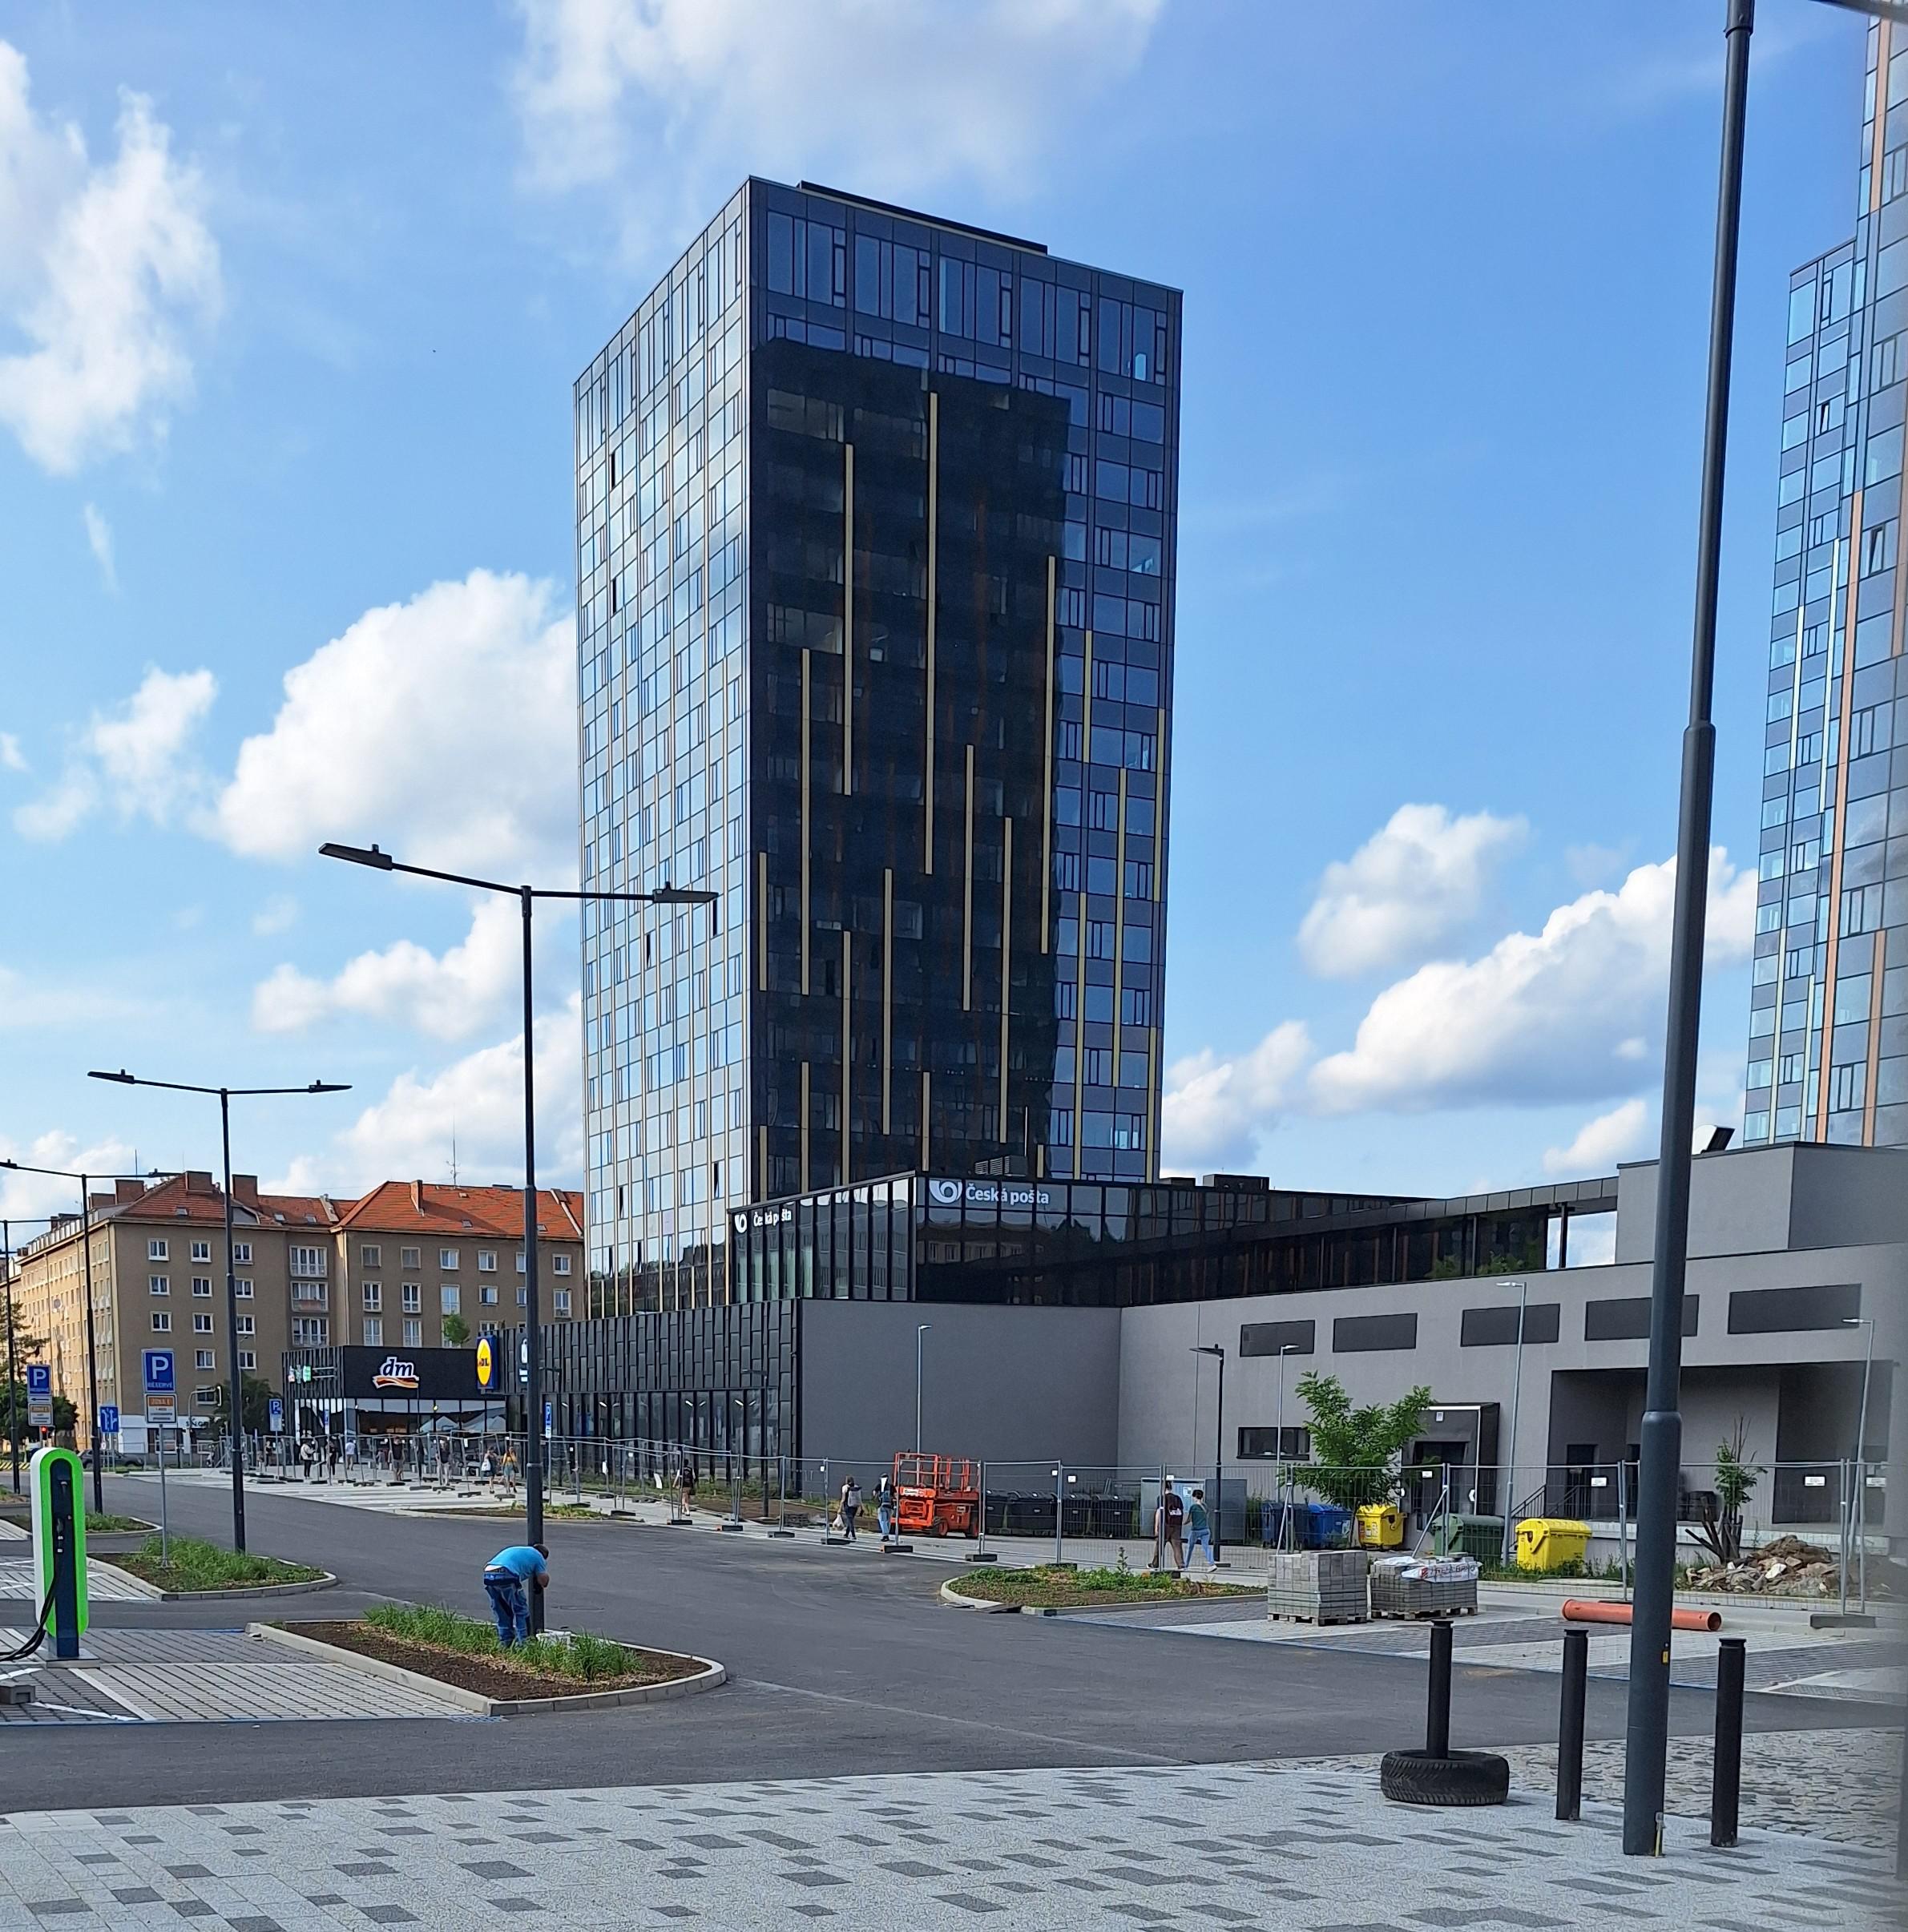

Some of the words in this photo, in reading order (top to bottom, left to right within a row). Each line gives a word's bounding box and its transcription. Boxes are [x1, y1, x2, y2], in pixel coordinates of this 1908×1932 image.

[966, 1183, 1007, 1201] Česká
[1010, 1189, 1049, 1205] pošta
[753, 1210, 772, 1227] Čeká
[33, 1368, 46, 1386] P
[151, 1356, 169, 1380] P
[381, 1357, 413, 1377] dm
